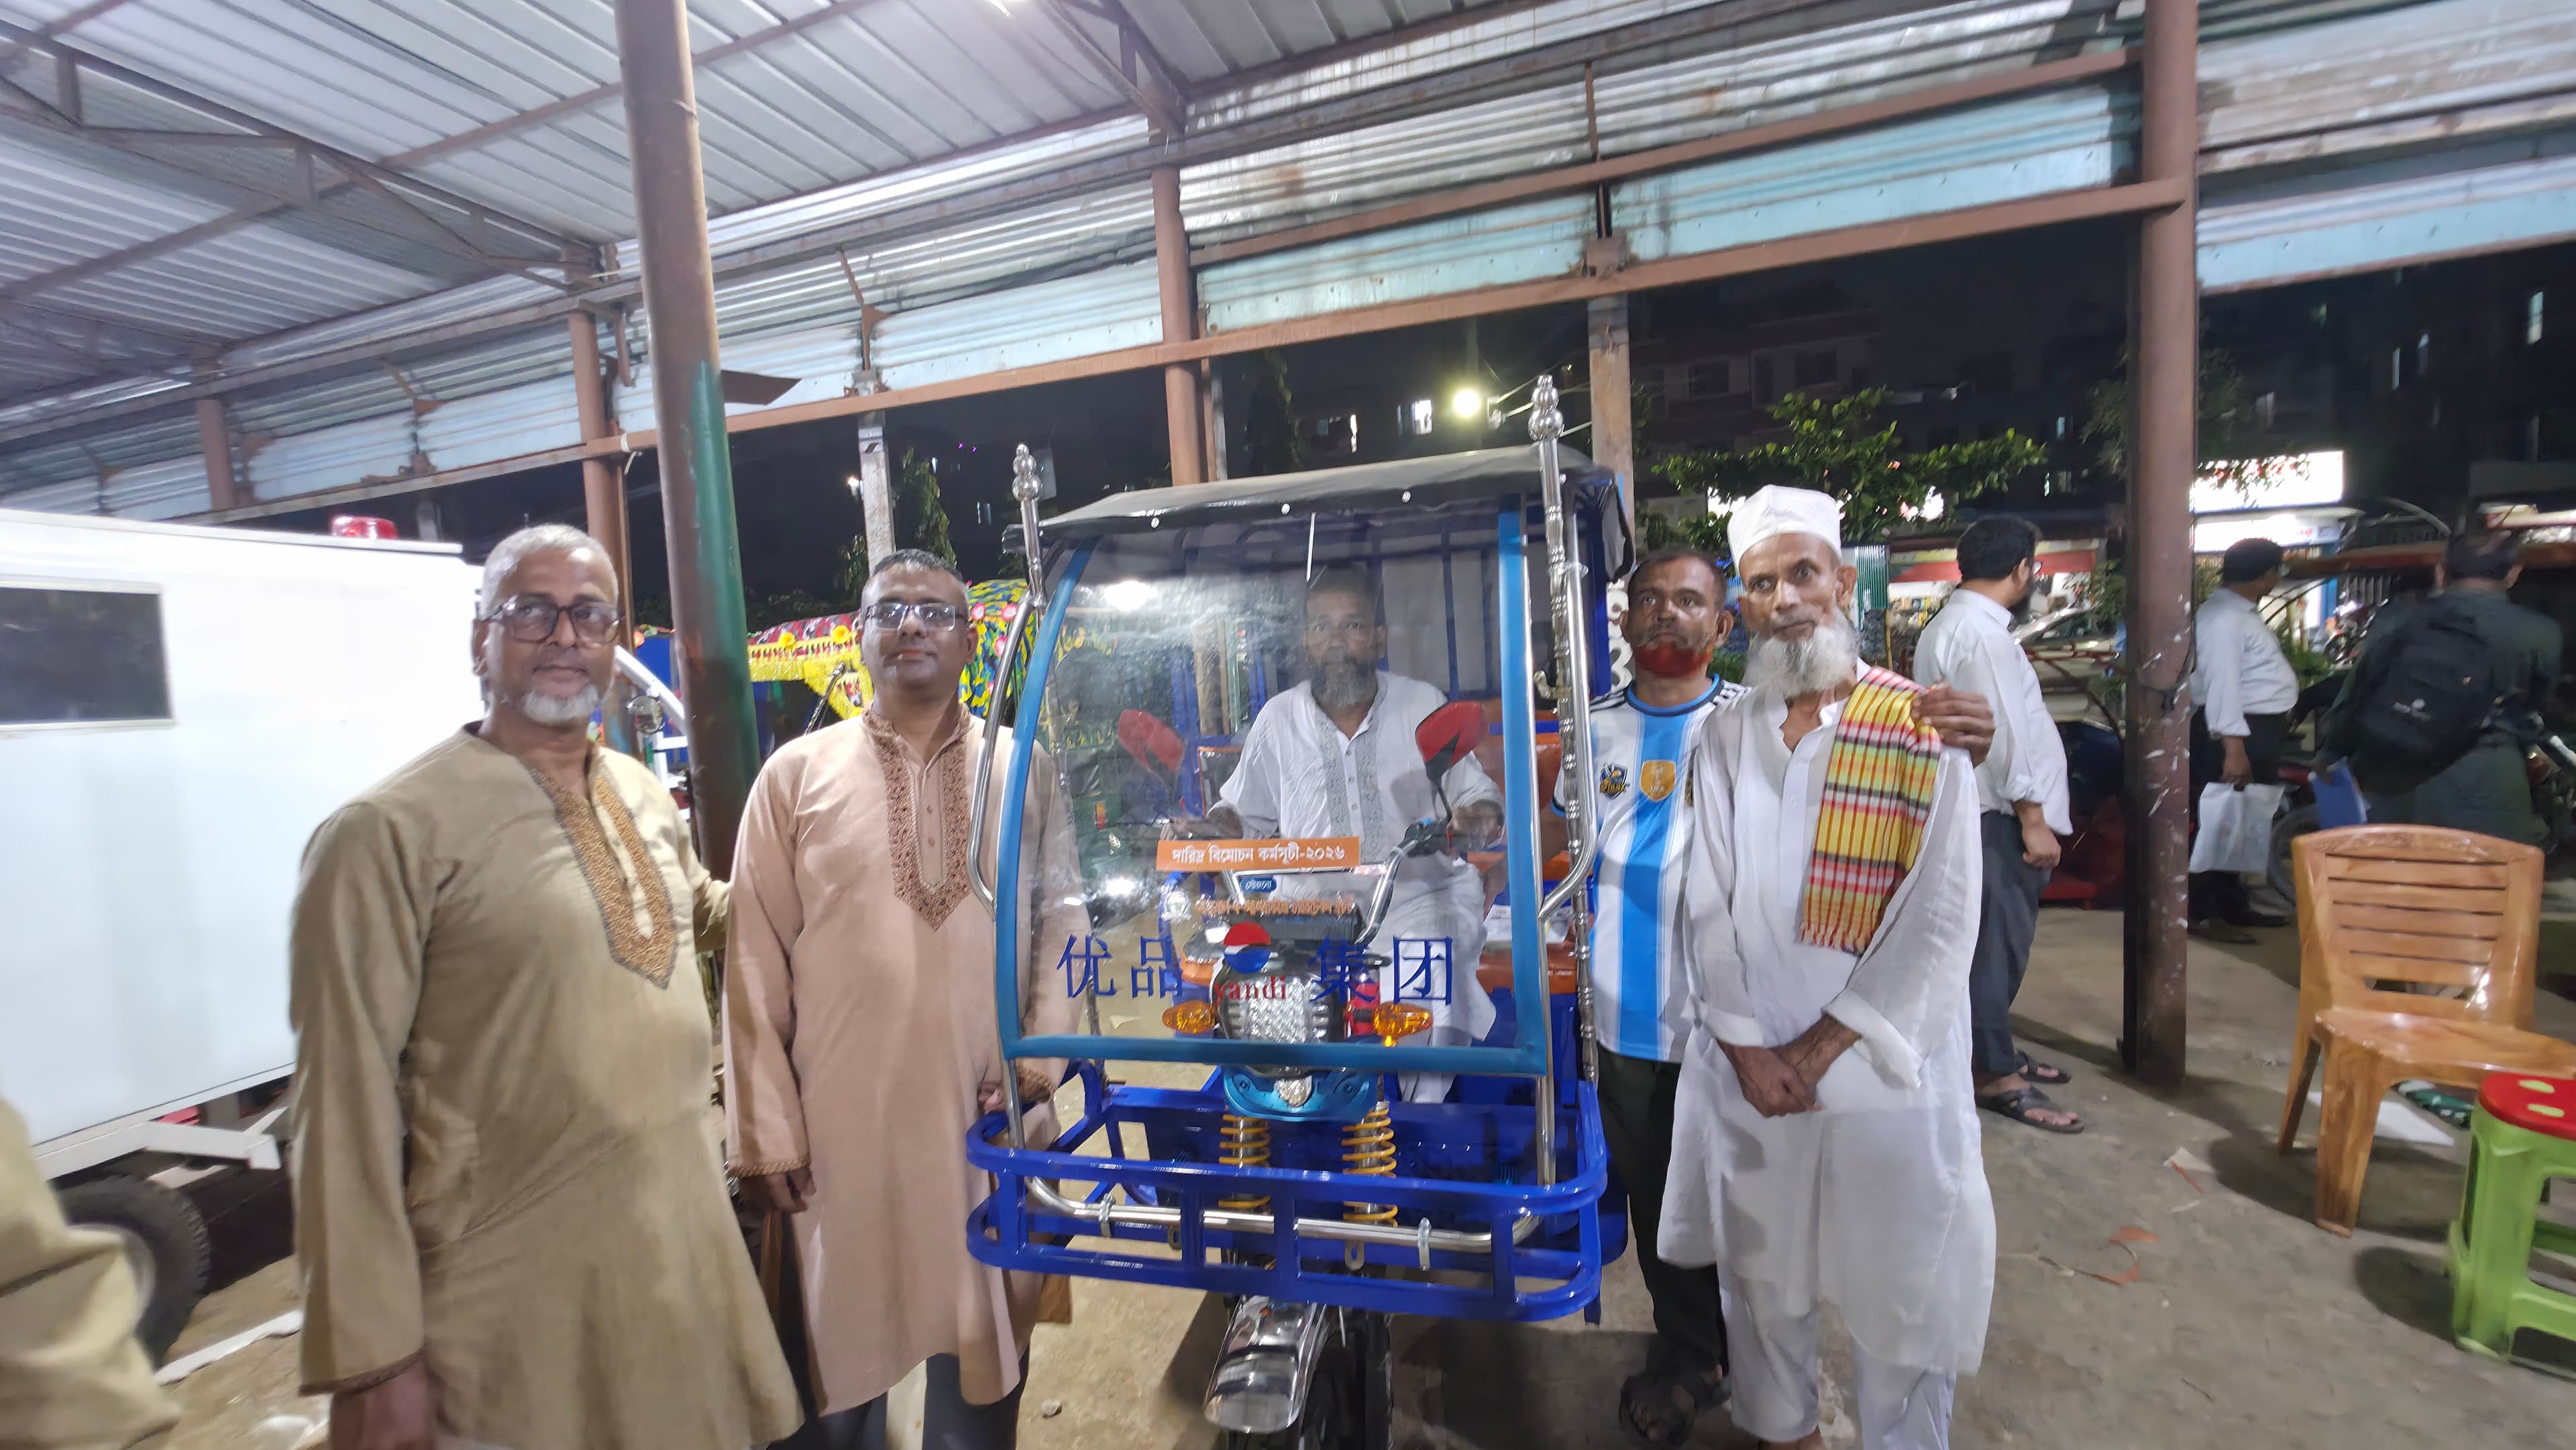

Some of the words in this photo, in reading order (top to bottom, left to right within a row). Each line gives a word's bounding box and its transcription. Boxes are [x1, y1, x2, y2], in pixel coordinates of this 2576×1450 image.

[1209, 845, 1254, 863] বিমোচন
[1057, 934, 1183, 998] 优品
[1308, 935, 1452, 1005] 集团
